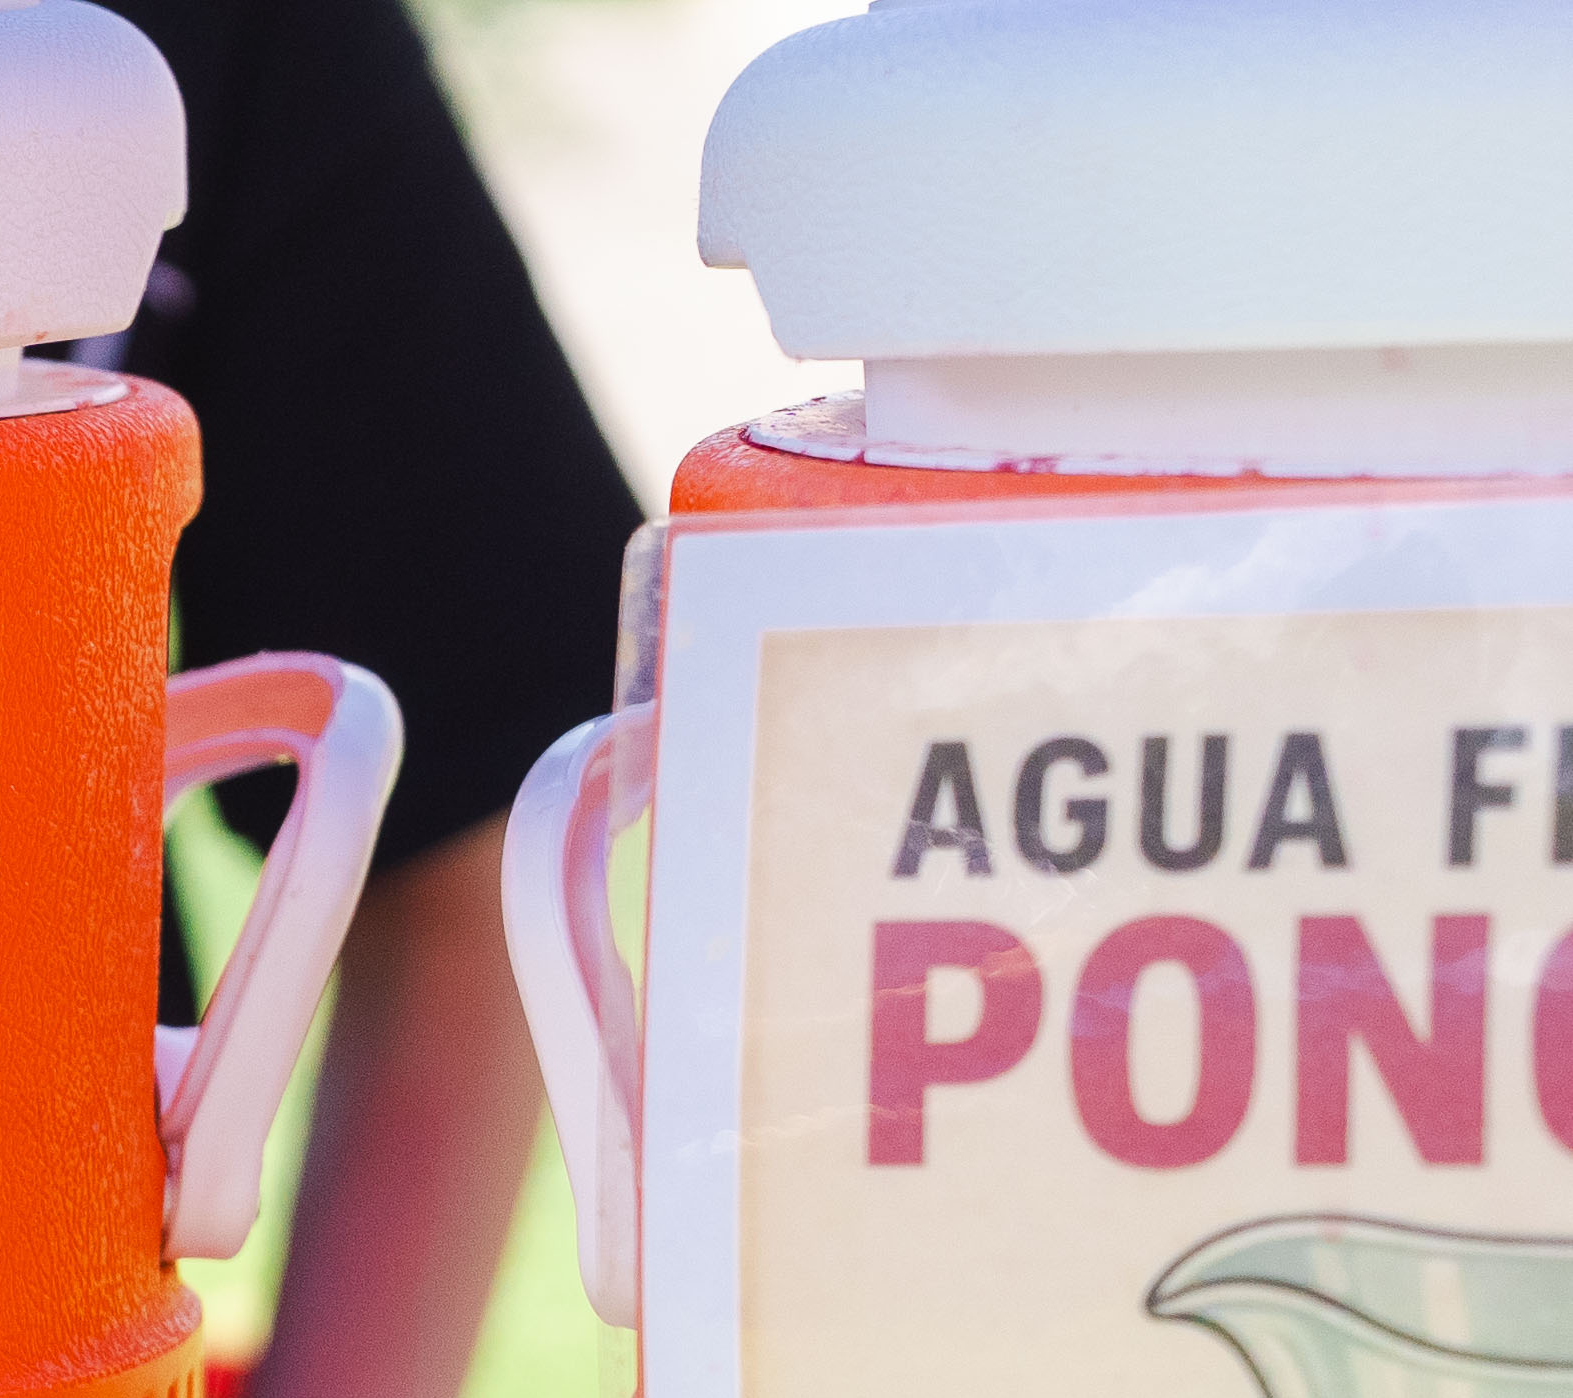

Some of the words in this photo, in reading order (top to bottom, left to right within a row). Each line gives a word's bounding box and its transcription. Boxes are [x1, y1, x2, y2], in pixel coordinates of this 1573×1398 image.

[891, 731, 1350, 879] AGUA
[1444, 726, 1573, 870] F
[866, 913, 1573, 1171] PON
